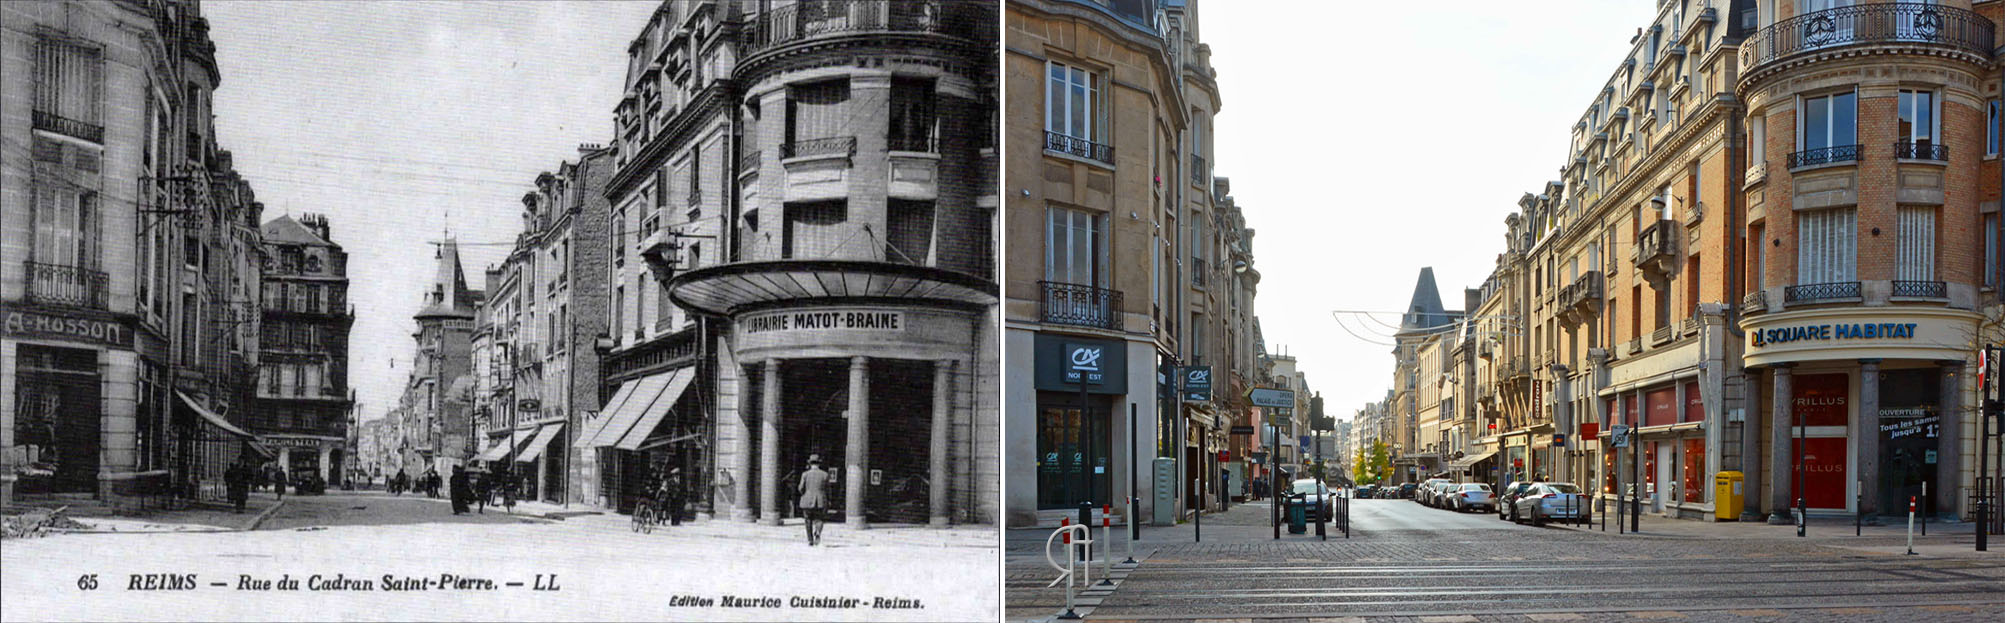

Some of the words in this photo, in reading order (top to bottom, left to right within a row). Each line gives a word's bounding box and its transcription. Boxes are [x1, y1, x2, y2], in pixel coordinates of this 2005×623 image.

[748, 315, 789, 334] LIBRAIRIE
[794, 312, 899, 330] MATOT-BRAINE
[1767, 325, 1831, 343] SQUARE
[1836, 323, 1917, 339] HABITAT
[1089, 373, 1102, 381] EST
[1900, 420, 1913, 428] les
